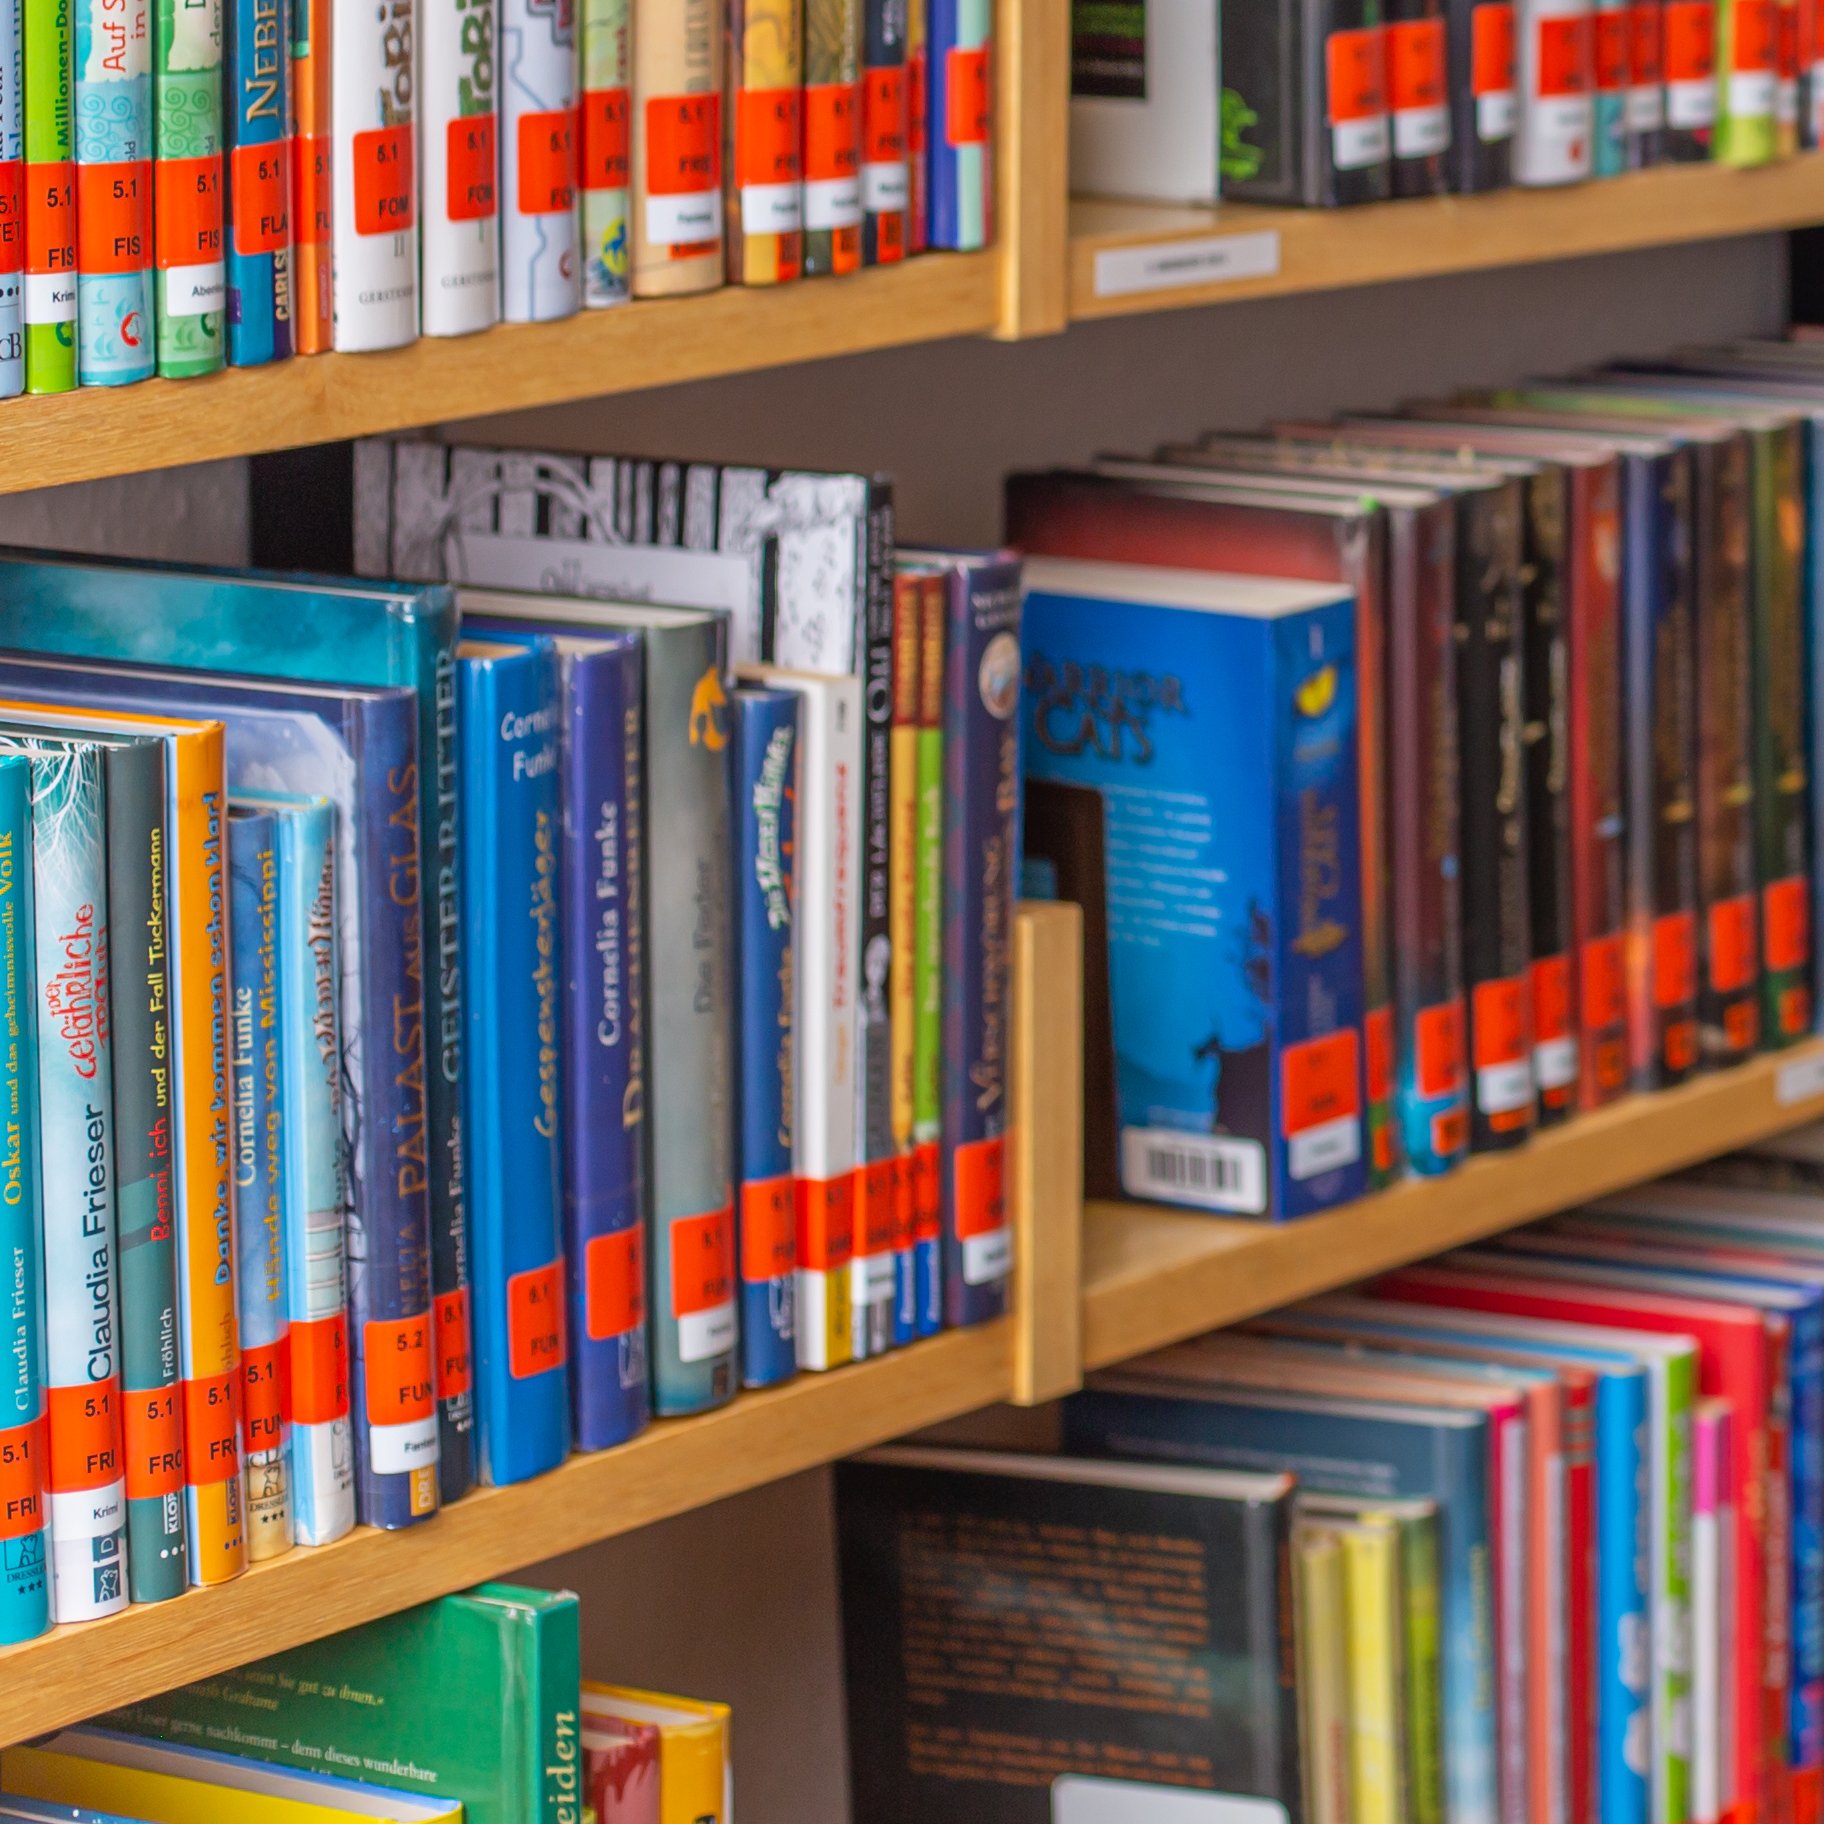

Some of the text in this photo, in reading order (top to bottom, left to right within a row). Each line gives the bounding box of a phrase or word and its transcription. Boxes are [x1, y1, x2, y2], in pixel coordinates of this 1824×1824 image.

[129, 11, 146, 41] in
[102, 22, 128, 72] Auf
[197, 174, 218, 194] 5.1
[258, 159, 280, 180] 5.1
[47, 187, 71, 208] 5.1
[113, 179, 137, 199] 5.1
[114, 236, 141, 257] FIS
[198, 229, 221, 251] FIS
[48, 245, 75, 268] FIS
[389, 763, 419, 905] GLAS
[594, 801, 621, 1047] Cornelia Funke
[4, 901, 20, 1038] geheimnisvolle
[530, 808, 557, 1138] Gespensterjäger
[146, 826, 171, 1241] Benni, ich und der Fall Tuckermann
[201, 791, 234, 1286] Danke, wir kommen schon klar!
[7, 1042, 20, 1075] das
[257, 847, 282, 1301] Hände weg von Mississippi
[6, 1078, 20, 1116] und
[232, 985, 258, 1187] Cornelia Funke
[396, 993, 427, 1199] PALAST
[2, 1120, 22, 1207] Oskar
[82, 1103, 112, 1381] Claudia Frieser
[11, 1246, 30, 1411] Claudia Frieser
[160, 1307, 176, 1379] Fröhlich
[397, 1330, 423, 1351] 5.2
[247, 1362, 273, 1384] 5.1
[85, 1394, 109, 1417] 5.1
[147, 1397, 173, 1420] 5.1
[208, 1383, 231, 1406] 5.1
[2, 1440, 29, 1463] 5.1
[86, 1449, 115, 1474] FRI
[6, 1494, 37, 1520] FRI
[93, 1502, 119, 1520] Krimi
[205, 1724, 279, 1752] nachkommt
[291, 1738, 322, 1761] denn
[324, 1743, 361, 1769] dieses
[363, 1755, 439, 1784] wunderbare
